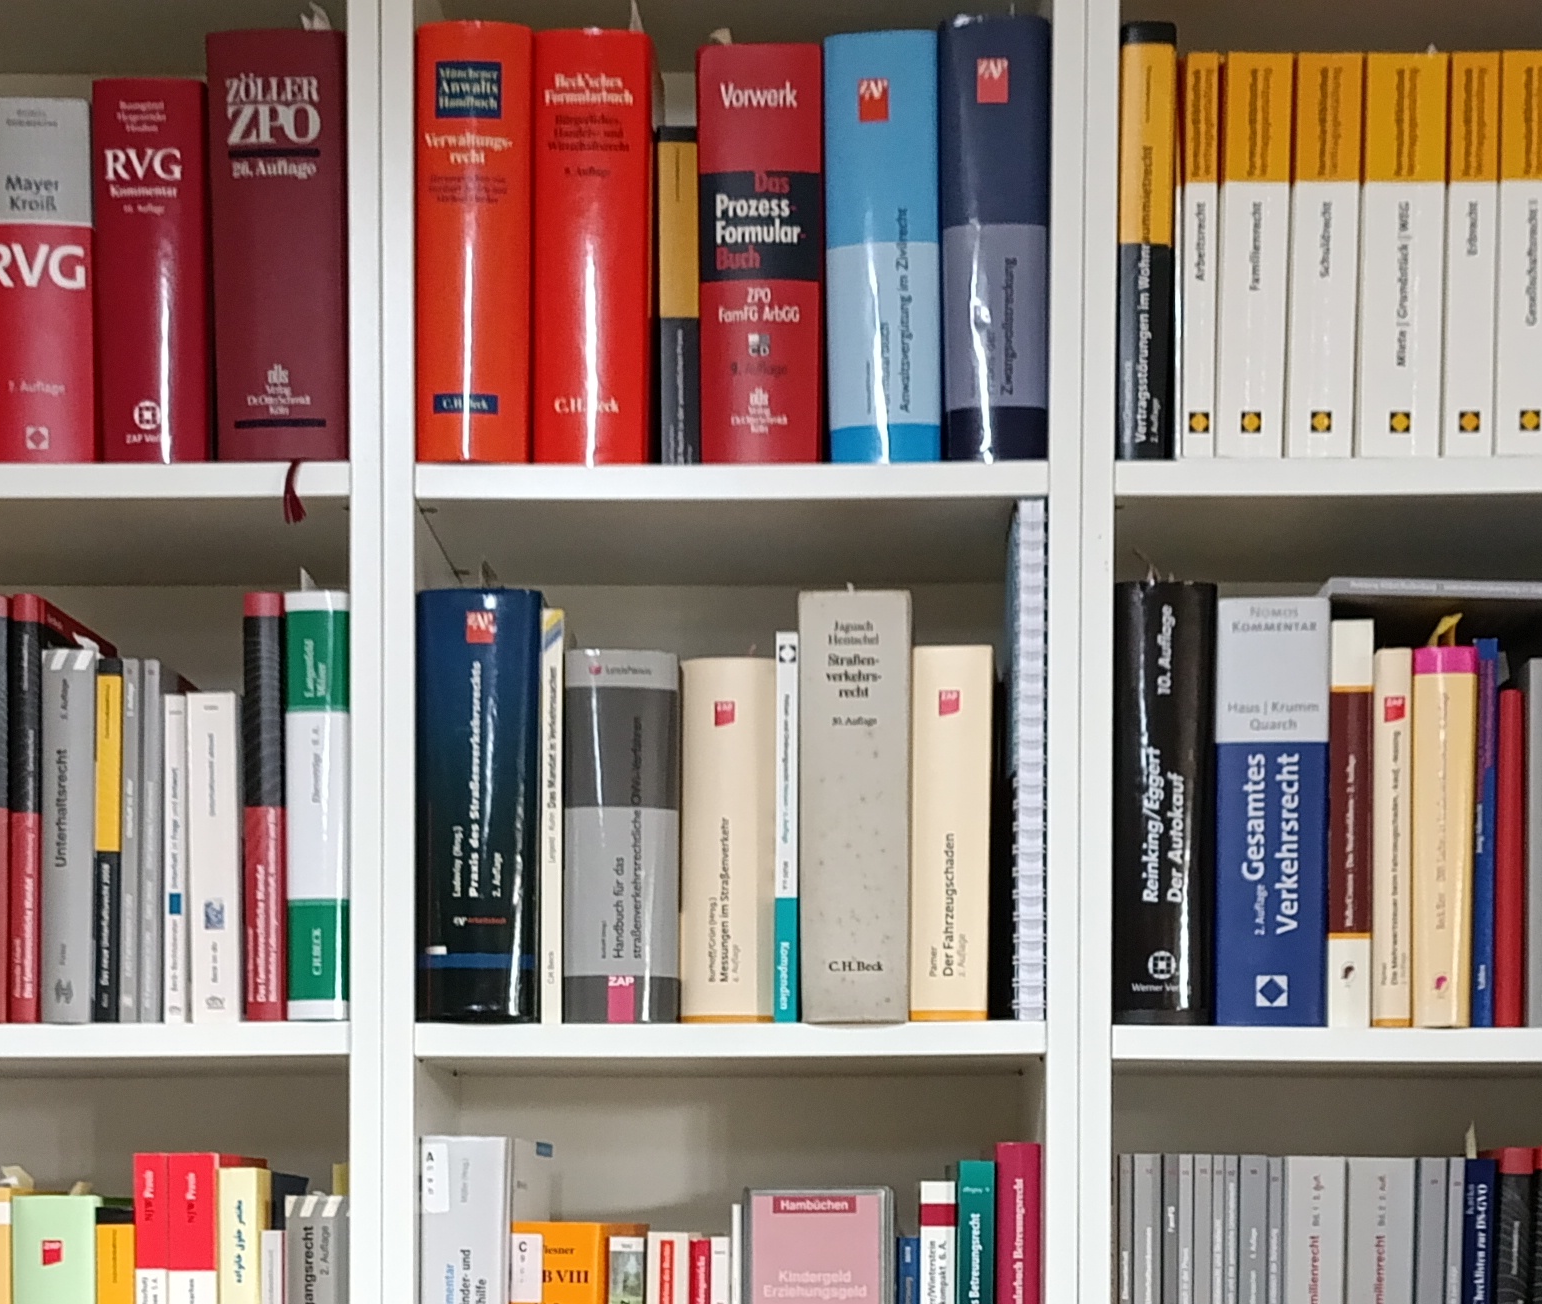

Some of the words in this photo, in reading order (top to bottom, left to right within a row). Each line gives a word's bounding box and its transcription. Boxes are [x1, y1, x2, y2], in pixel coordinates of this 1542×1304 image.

[225, 73, 320, 102] ZÖLLER
[720, 82, 798, 109] Vorwerk
[227, 102, 321, 146] ZPO
[105, 148, 183, 181] RVG
[5, 174, 60, 193] Mayer
[754, 173, 790, 194] Das
[8, 194, 57, 213] Kroiß
[716, 193, 796, 218] Prozess-
[716, 218, 806, 245] Formular-
[716, 246, 760, 270] Buch
[747, 287, 772, 304] ZPO
[718, 306, 758, 323] FamFG
[763, 306, 801, 323] ArbGG
[827, 654, 880, 668] Straßen-
[826, 669, 881, 685] verkehrs-
[839, 684, 869, 699] recht
[1228, 700, 1263, 714] Haus
[1273, 700, 1319, 715] Krumm
[1250, 718, 1298, 732] Quarch
[55, 749, 68, 868] Unterhaltsrecht
[1167, 774, 1185, 867] Autokauf
[1241, 752, 1266, 882] Gesamtes
[1143, 747, 1162, 903] Reinking/Eggert
[1275, 752, 1300, 935] Verkehrsrecht
[943, 833, 956, 948] Fahrzeugschaden
[1167, 871, 1183, 903] Der
[779, 940, 790, 1011] Kompendien
[943, 952, 955, 977] Der
[779, 1198, 849, 1212] Hambüchen
[778, 1268, 852, 1285] Kindergeld
[764, 1284, 867, 1300] Erziehungsgeld
